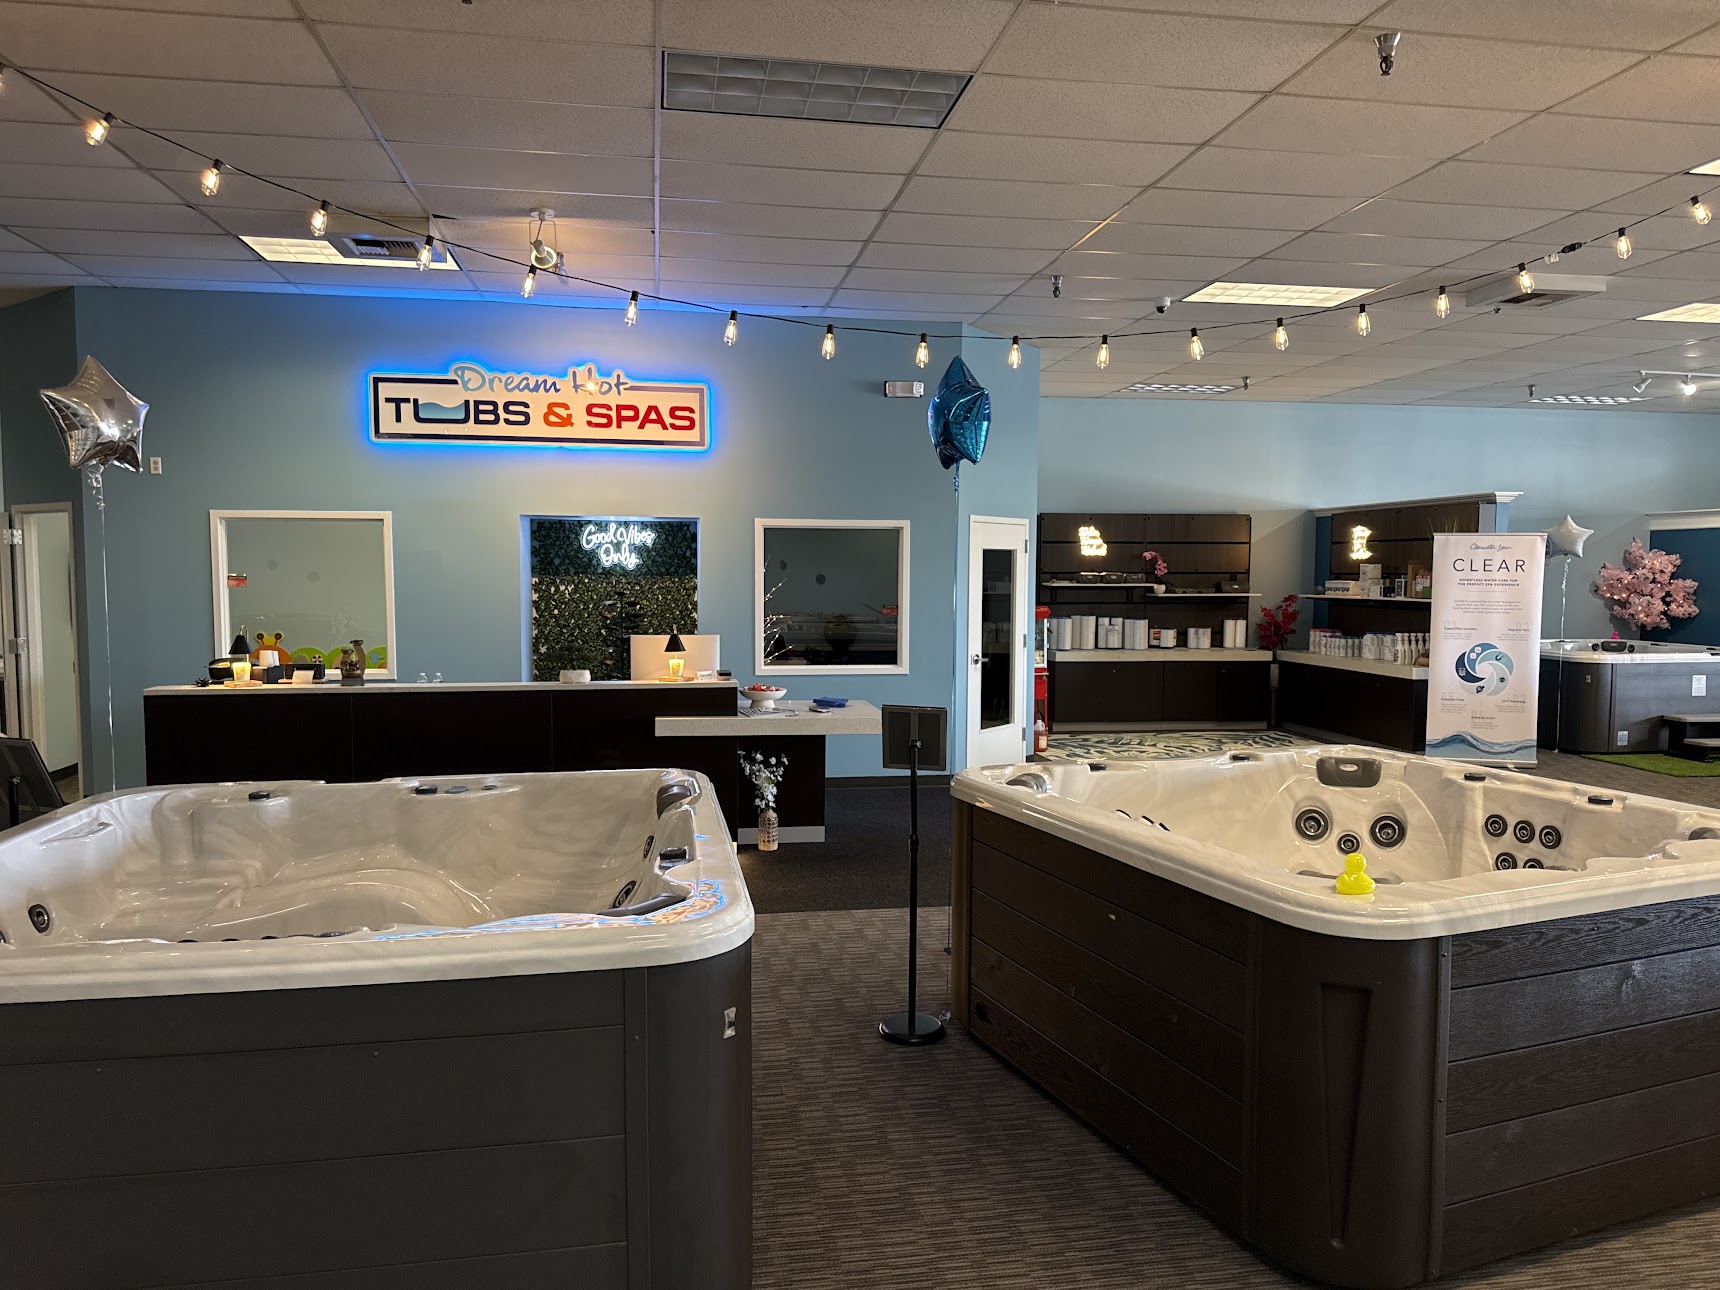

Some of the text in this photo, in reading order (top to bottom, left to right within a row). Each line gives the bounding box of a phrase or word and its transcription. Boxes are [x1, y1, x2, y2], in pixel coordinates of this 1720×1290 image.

[454, 365, 631, 397] Dream Hot
[384, 397, 696, 431] TUBS & SPAS
[582, 522, 656, 549] Good Vibes
[600, 543, 640, 569] Only
[1452, 558, 1526, 573] CLEAR
